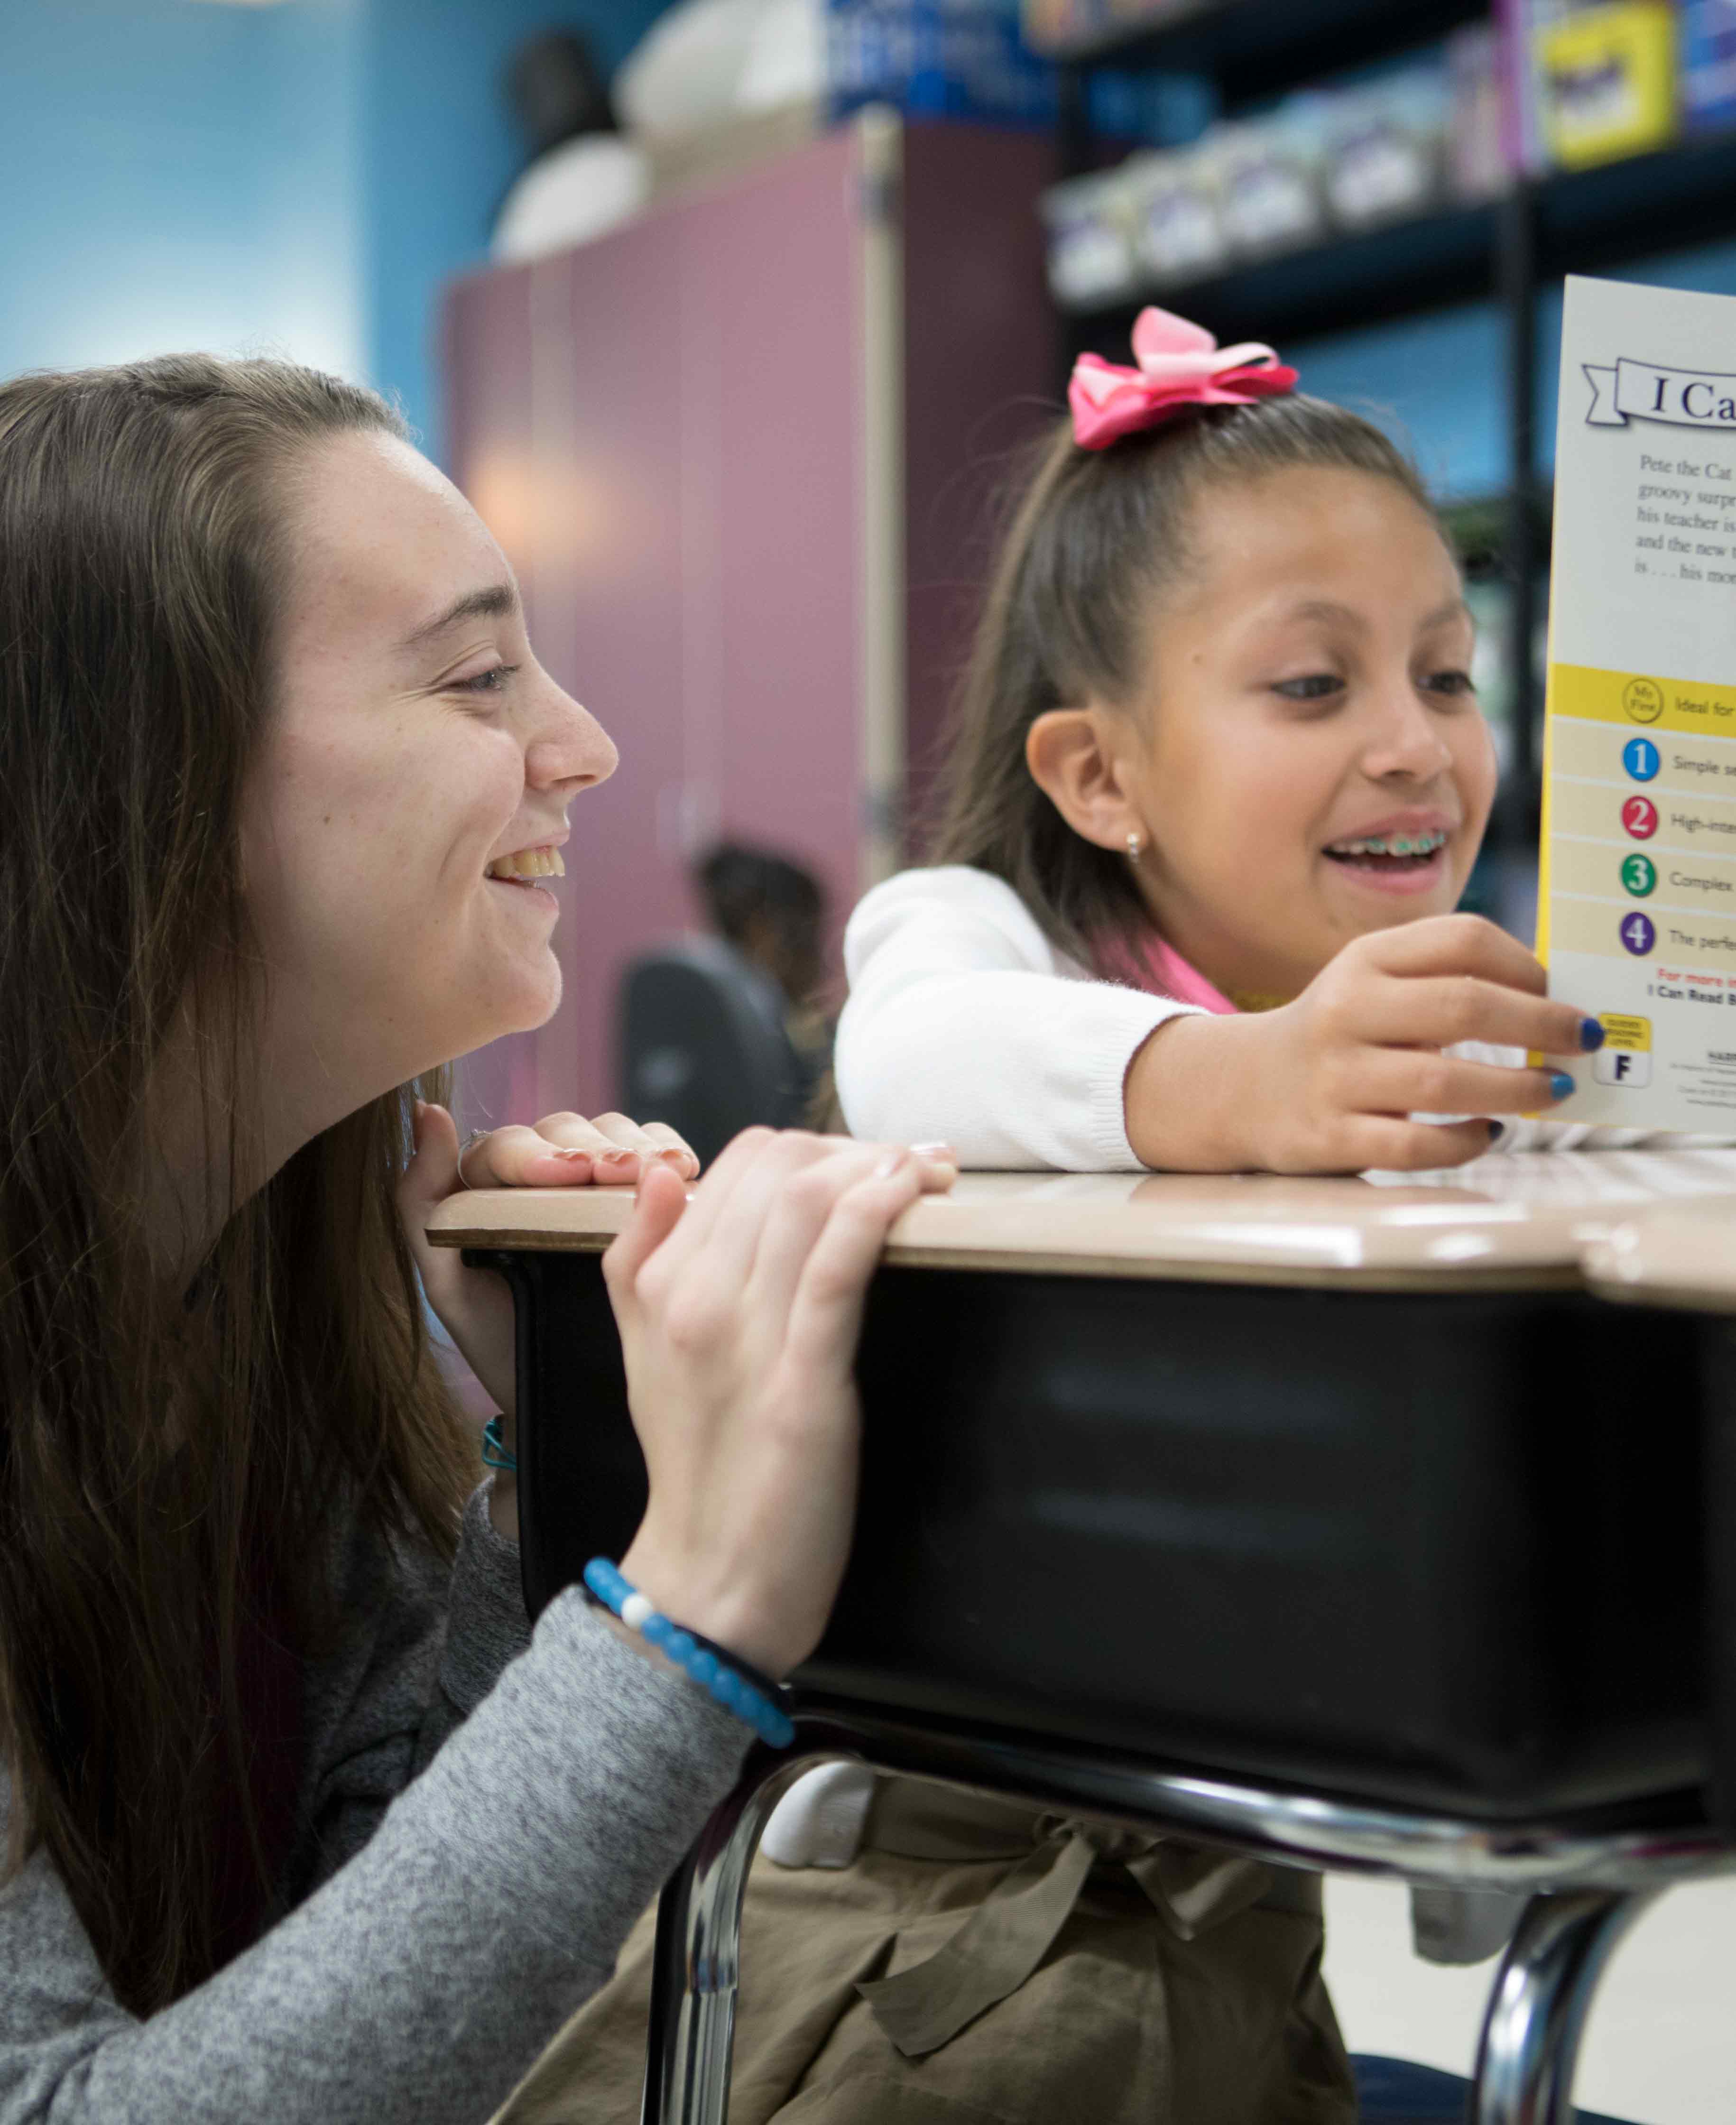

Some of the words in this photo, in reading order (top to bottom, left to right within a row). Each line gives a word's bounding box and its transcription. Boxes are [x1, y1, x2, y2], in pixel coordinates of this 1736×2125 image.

[1652, 377, 1670, 412] I
[1681, 382, 1736, 420] Ca
[1640, 454, 1673, 474] Pete
[1677, 459, 1700, 477] the
[1705, 462, 1732, 481] Cat
[1638, 485, 1691, 506] groovy
[1637, 506, 1660, 523] his
[1664, 512, 1718, 531] teacher
[1636, 534, 1663, 550] and
[1668, 536, 1692, 553] the
[1695, 544, 1727, 557] new
[1635, 557, 1648, 573] is
[1679, 563, 1702, 580] his
[1676, 696, 1709, 714] Ideal
[1713, 702, 1734, 717] for
[1634, 743, 1650, 774] 1
[1672, 755, 1719, 776] Simple
[1629, 801, 1649, 832] 2
[1628, 859, 1649, 890] 3
[1669, 871, 1733, 893] Complex
[1626, 918, 1647, 949] 4
[1667, 928, 1695, 946] The
[1658, 968, 1681, 982] For
[1685, 974, 1723, 987] more
[1648, 984, 1653, 995] I
[1658, 985, 1683, 1000] Can
[1689, 989, 1724, 1005] Read
[1615, 1054, 1631, 1080] F
